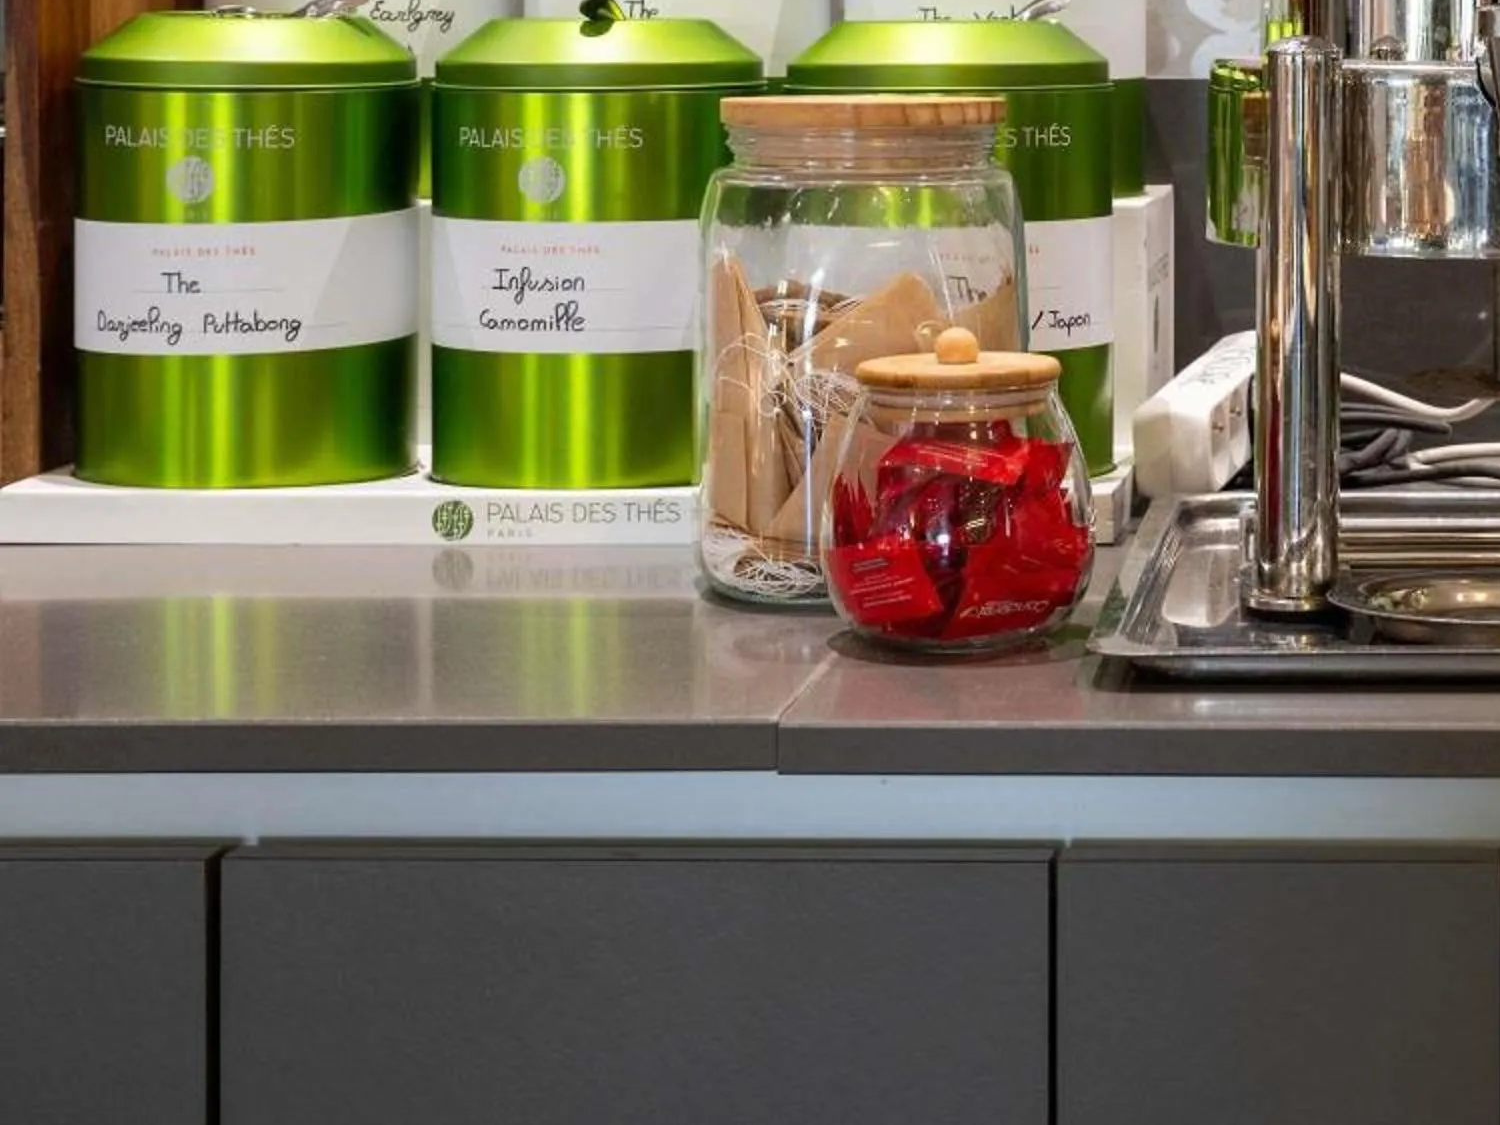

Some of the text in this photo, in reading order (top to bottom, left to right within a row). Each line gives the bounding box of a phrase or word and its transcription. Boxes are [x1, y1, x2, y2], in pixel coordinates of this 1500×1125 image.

[105, 125, 169, 147] PALAIS
[235, 125, 295, 149] THÉS
[459, 127, 523, 148] PALAIS
[584, 125, 643, 149] HÉS
[1023, 122, 1072, 147] THÉS
[160, 272, 201, 294] The
[492, 266, 585, 304] Infusion
[203, 309, 301, 342] Puttabong
[480, 300, 586, 332] Camomille
[487, 498, 682, 524] PALAIS DES THÉS
